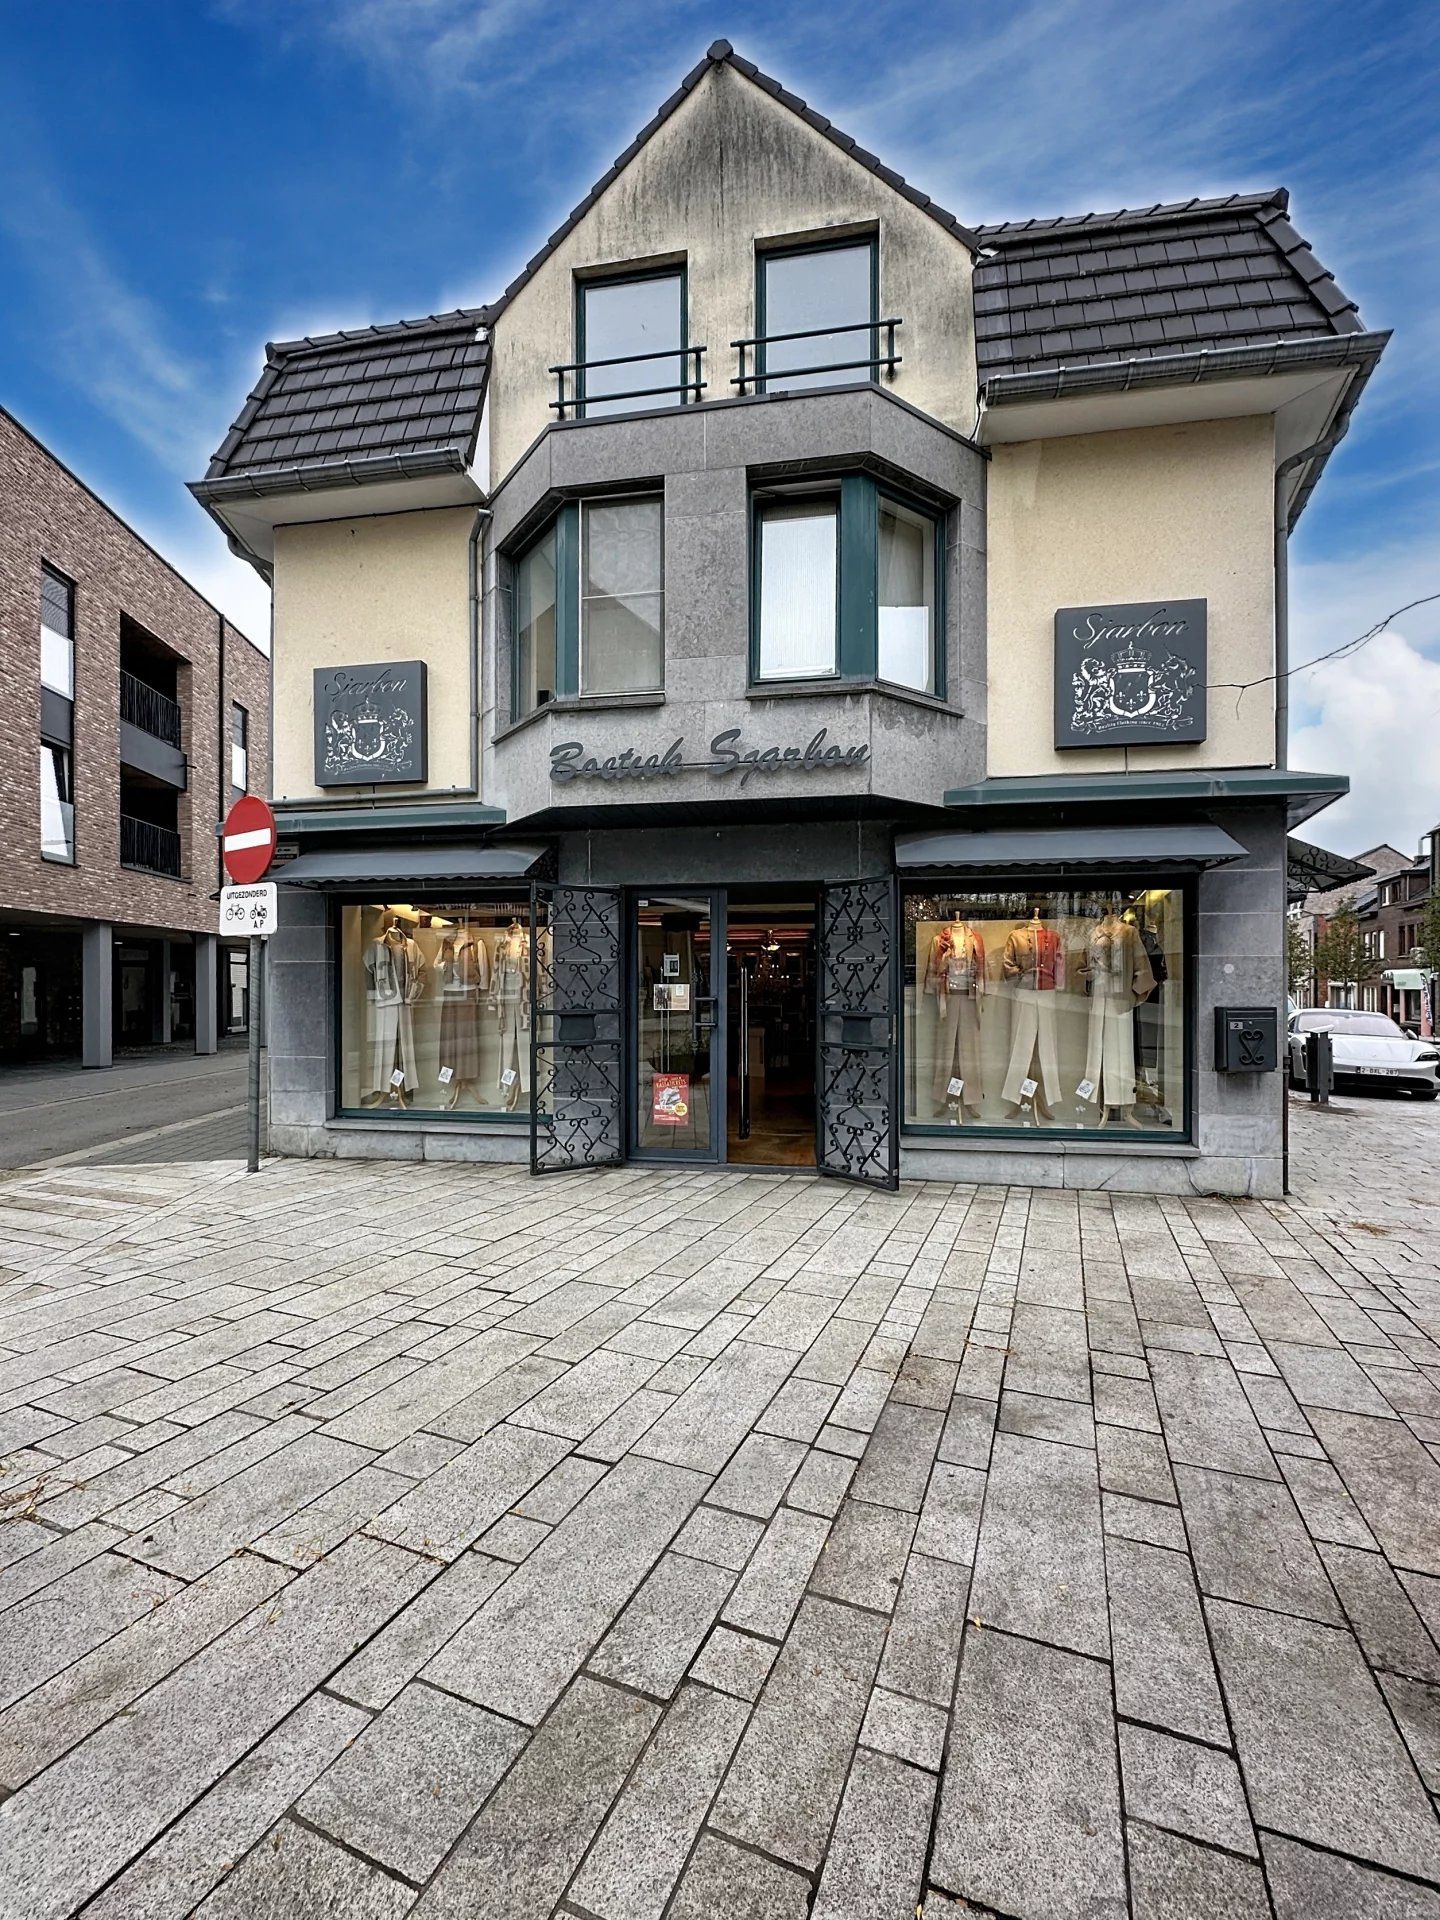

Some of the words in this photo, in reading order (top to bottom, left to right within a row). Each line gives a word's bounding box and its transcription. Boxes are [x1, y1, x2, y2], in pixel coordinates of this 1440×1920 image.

[1073, 608, 1189, 649] Sjarbon
[324, 669, 407, 702] Sjarbon
[707, 728, 872, 786] Sjarbon
[226, 889, 268, 899] UITGEZONDERD
